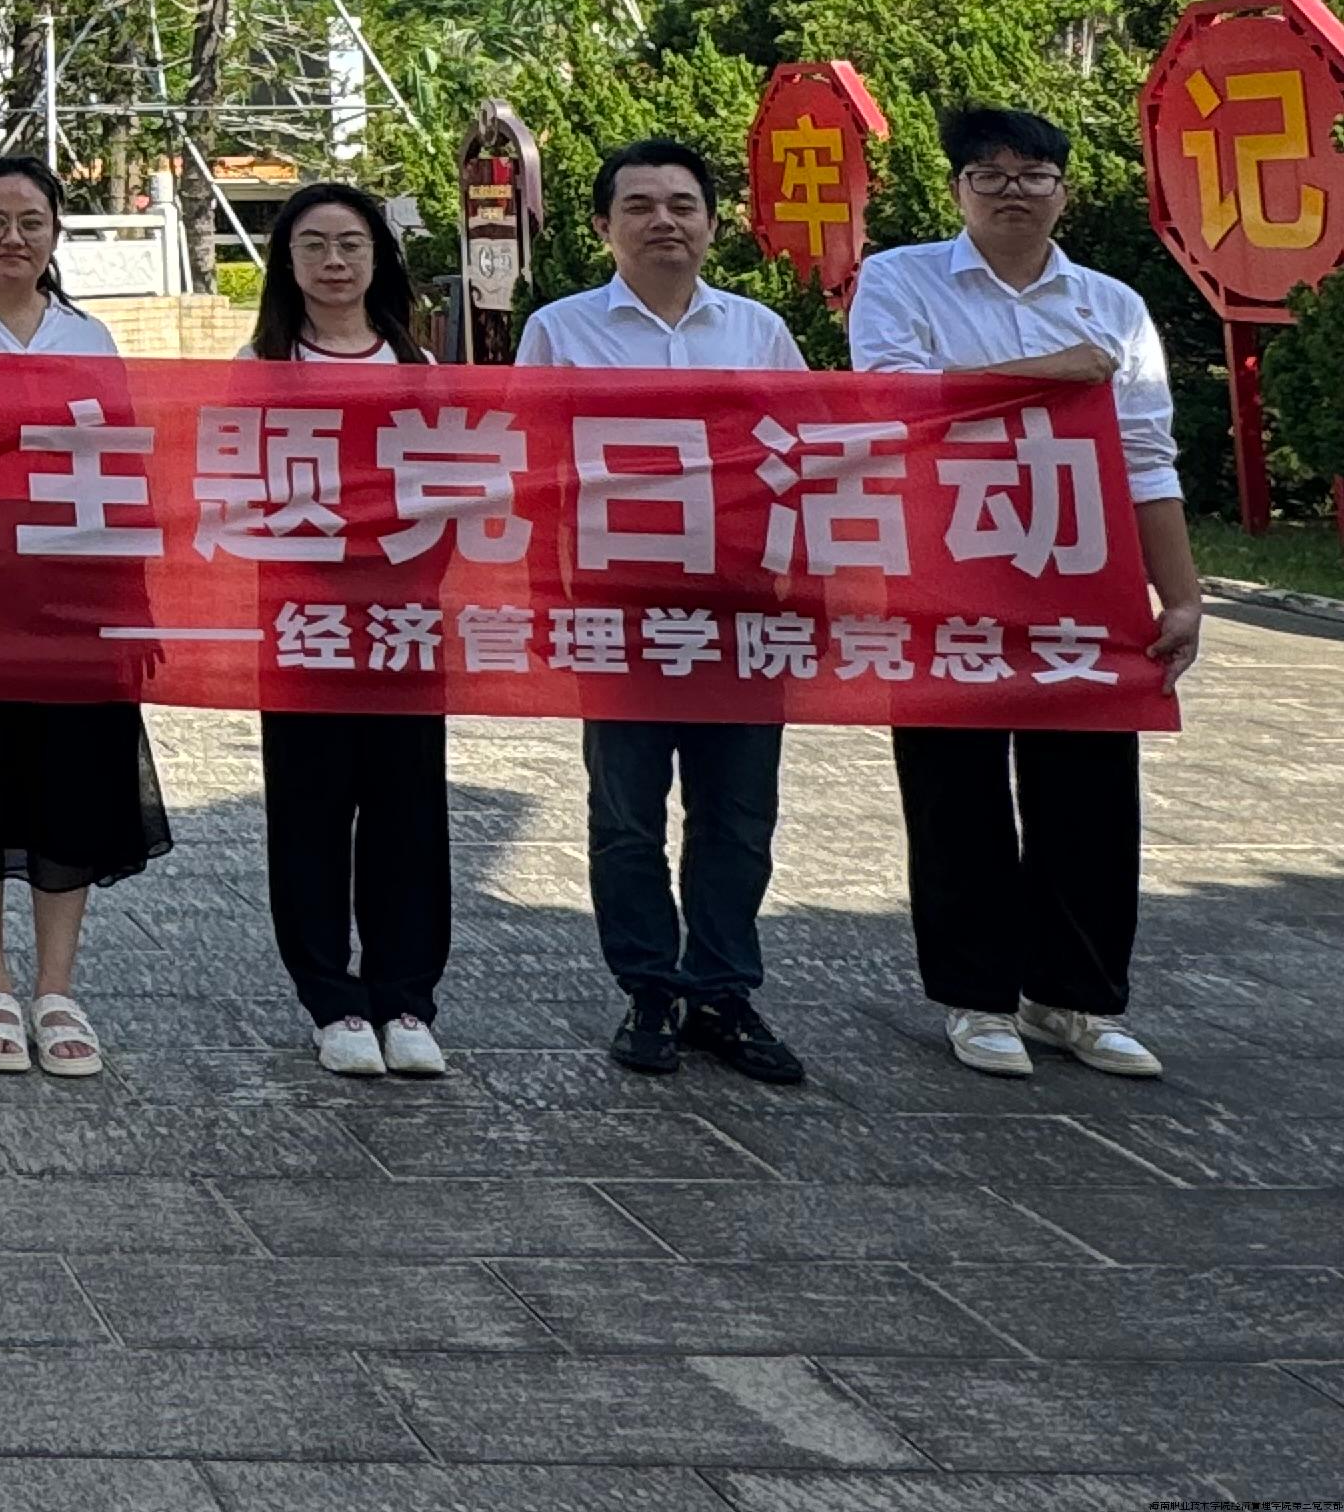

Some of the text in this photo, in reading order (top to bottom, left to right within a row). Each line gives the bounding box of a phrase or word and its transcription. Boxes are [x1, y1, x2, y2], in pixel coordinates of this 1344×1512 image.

[771, 114, 852, 259] 牢
[1182, 69, 1324, 250] 记
[16, 398, 1110, 578] 主题党日活动
